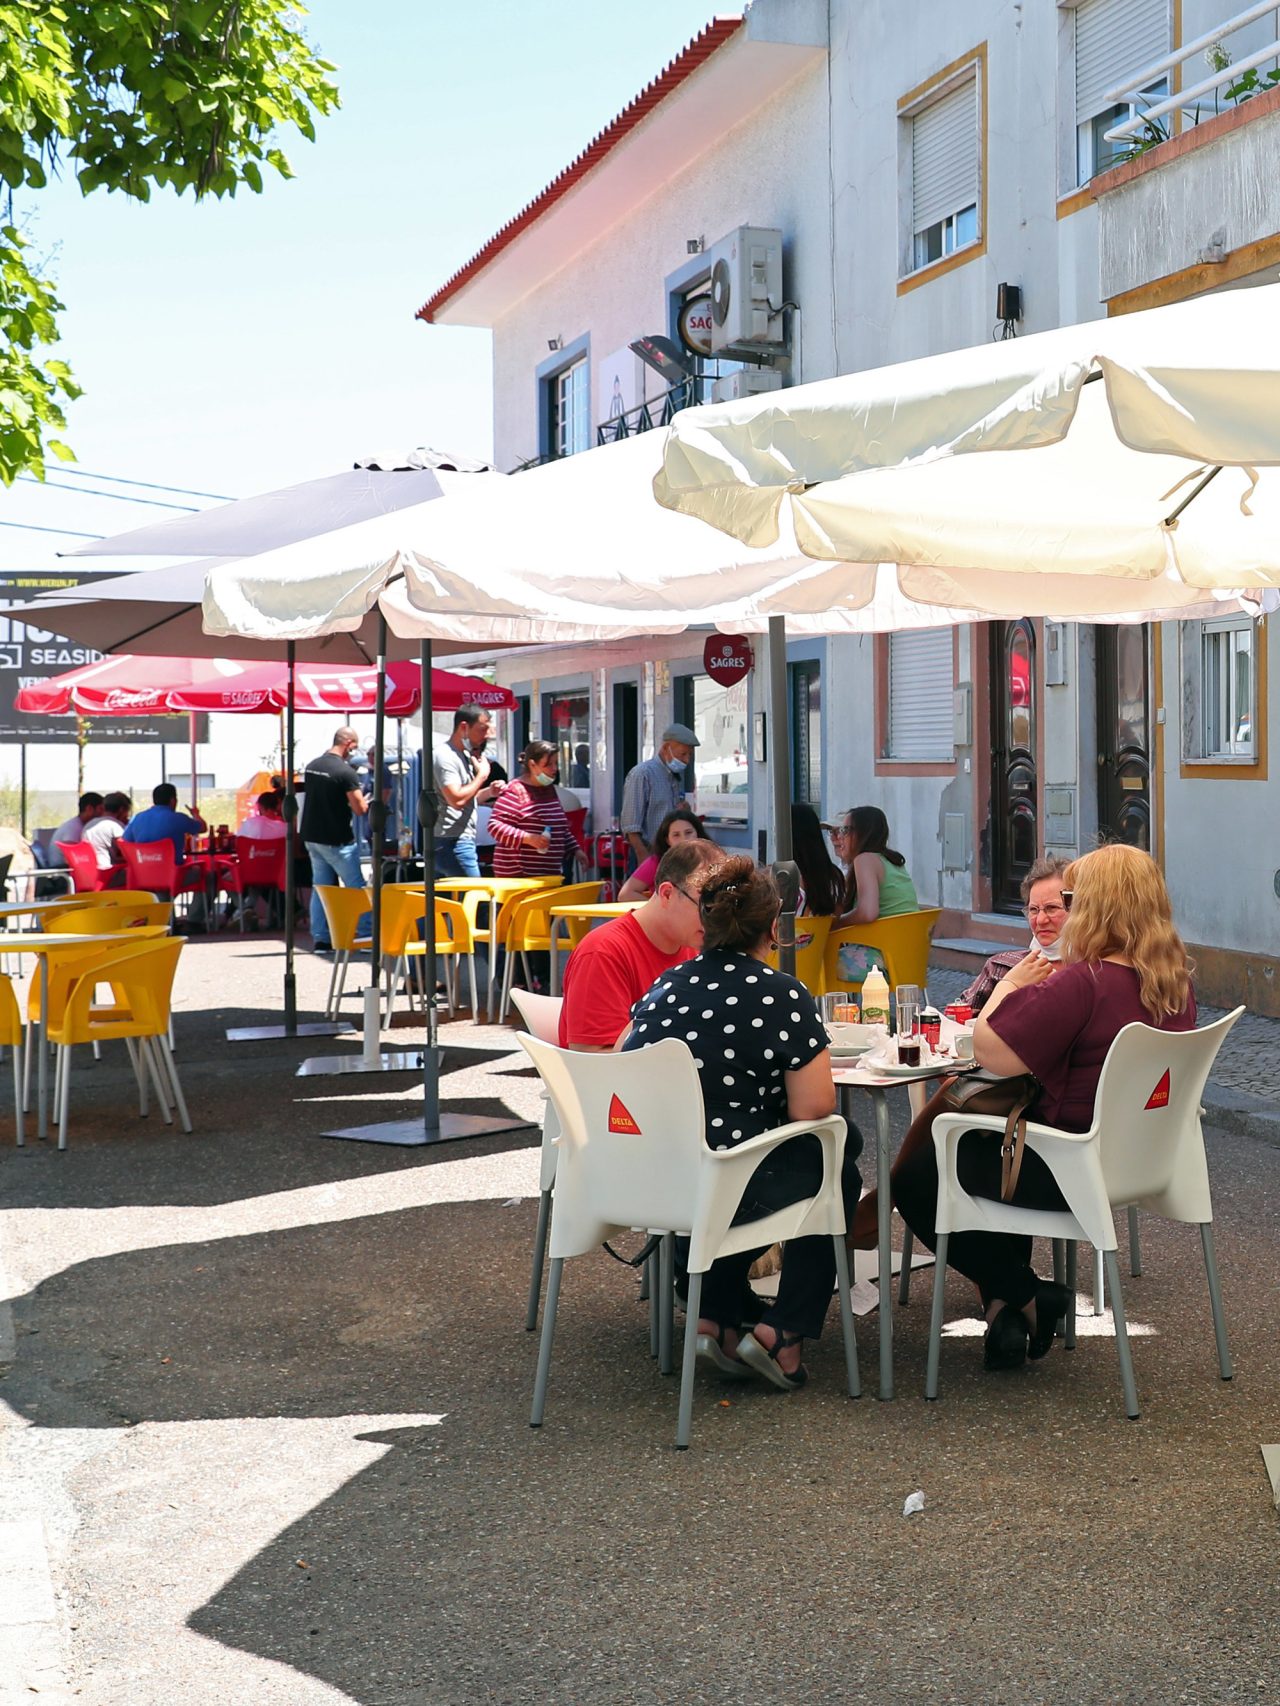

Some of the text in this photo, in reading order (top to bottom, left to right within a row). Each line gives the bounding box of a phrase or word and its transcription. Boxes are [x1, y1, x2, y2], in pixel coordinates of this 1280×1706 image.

[30, 648, 112, 665] SEASID
[710, 656, 745, 669] SAGRES
[471, 691, 505, 704] SAGRES
[611, 1117, 634, 1127] DELTA
